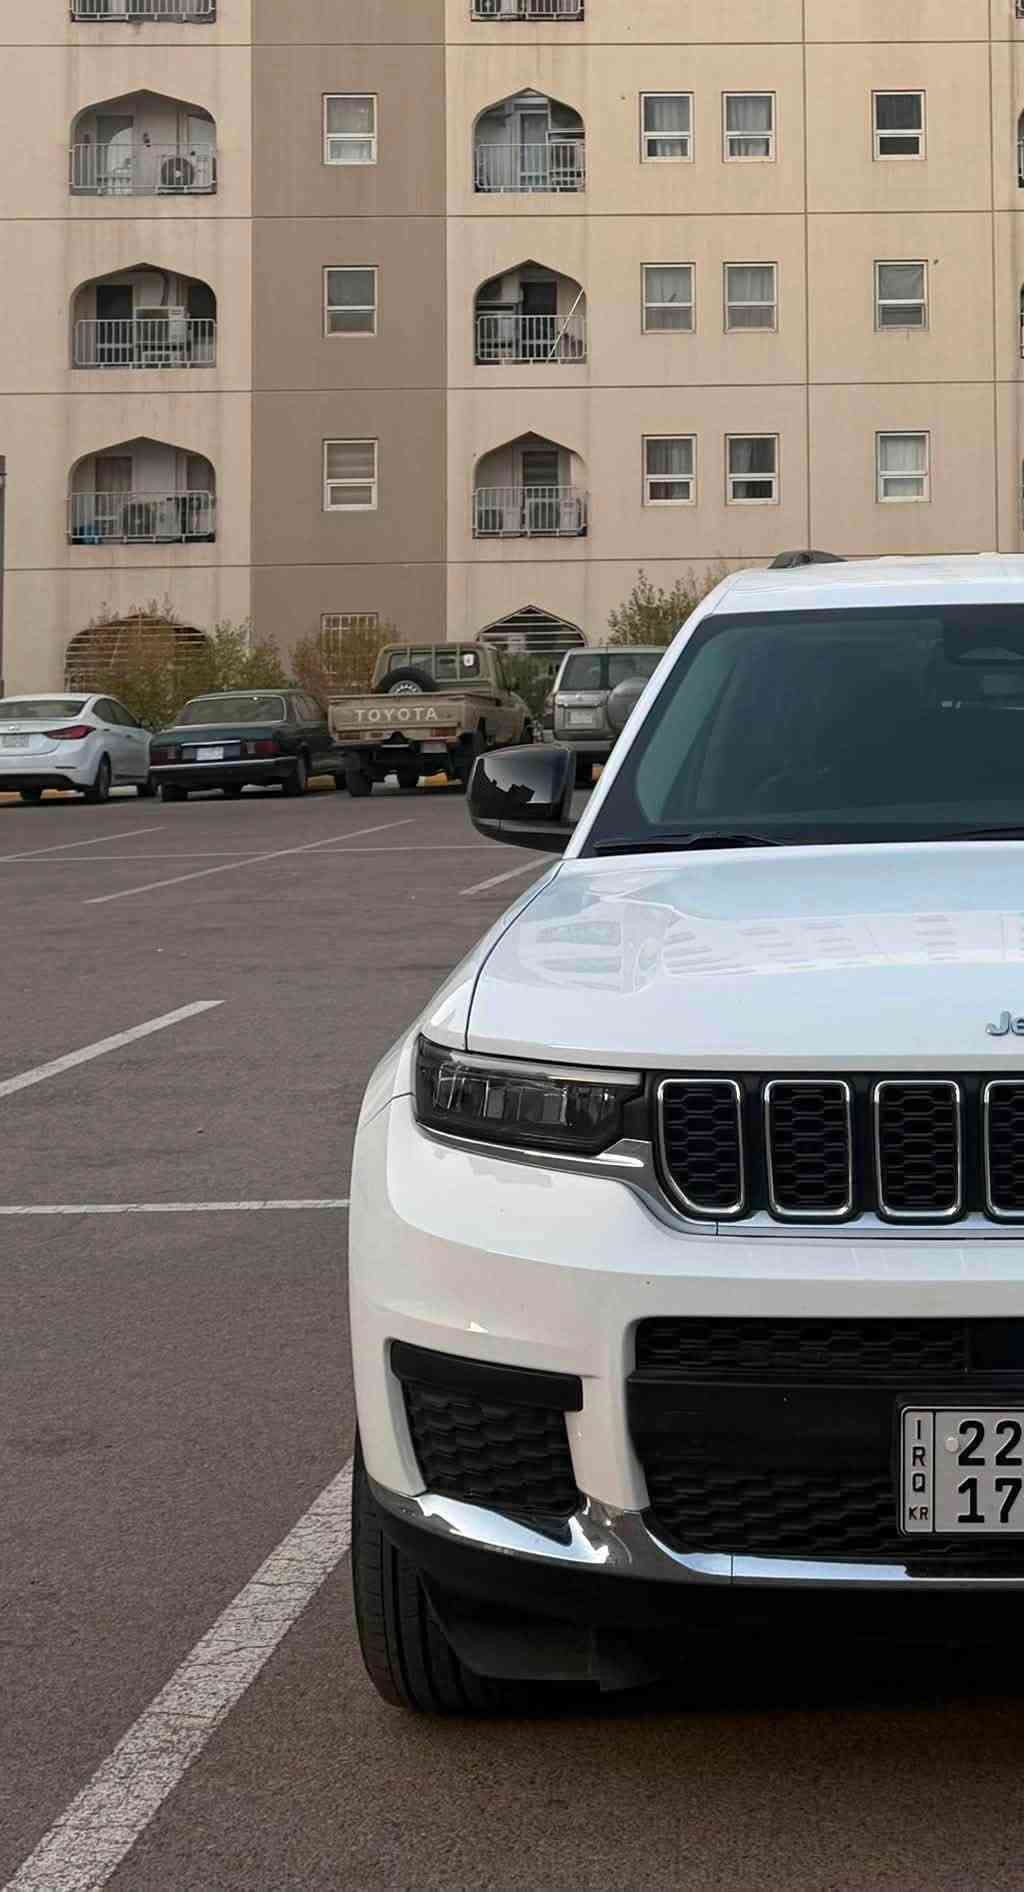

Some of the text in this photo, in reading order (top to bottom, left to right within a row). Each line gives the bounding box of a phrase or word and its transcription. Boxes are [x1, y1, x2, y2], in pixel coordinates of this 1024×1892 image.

[355, 706, 438, 721] TOYOTA
[911, 1419, 926, 1493] IRQ
[957, 1419, 1023, 1467] 22
[908, 1506, 929, 1521] KR
